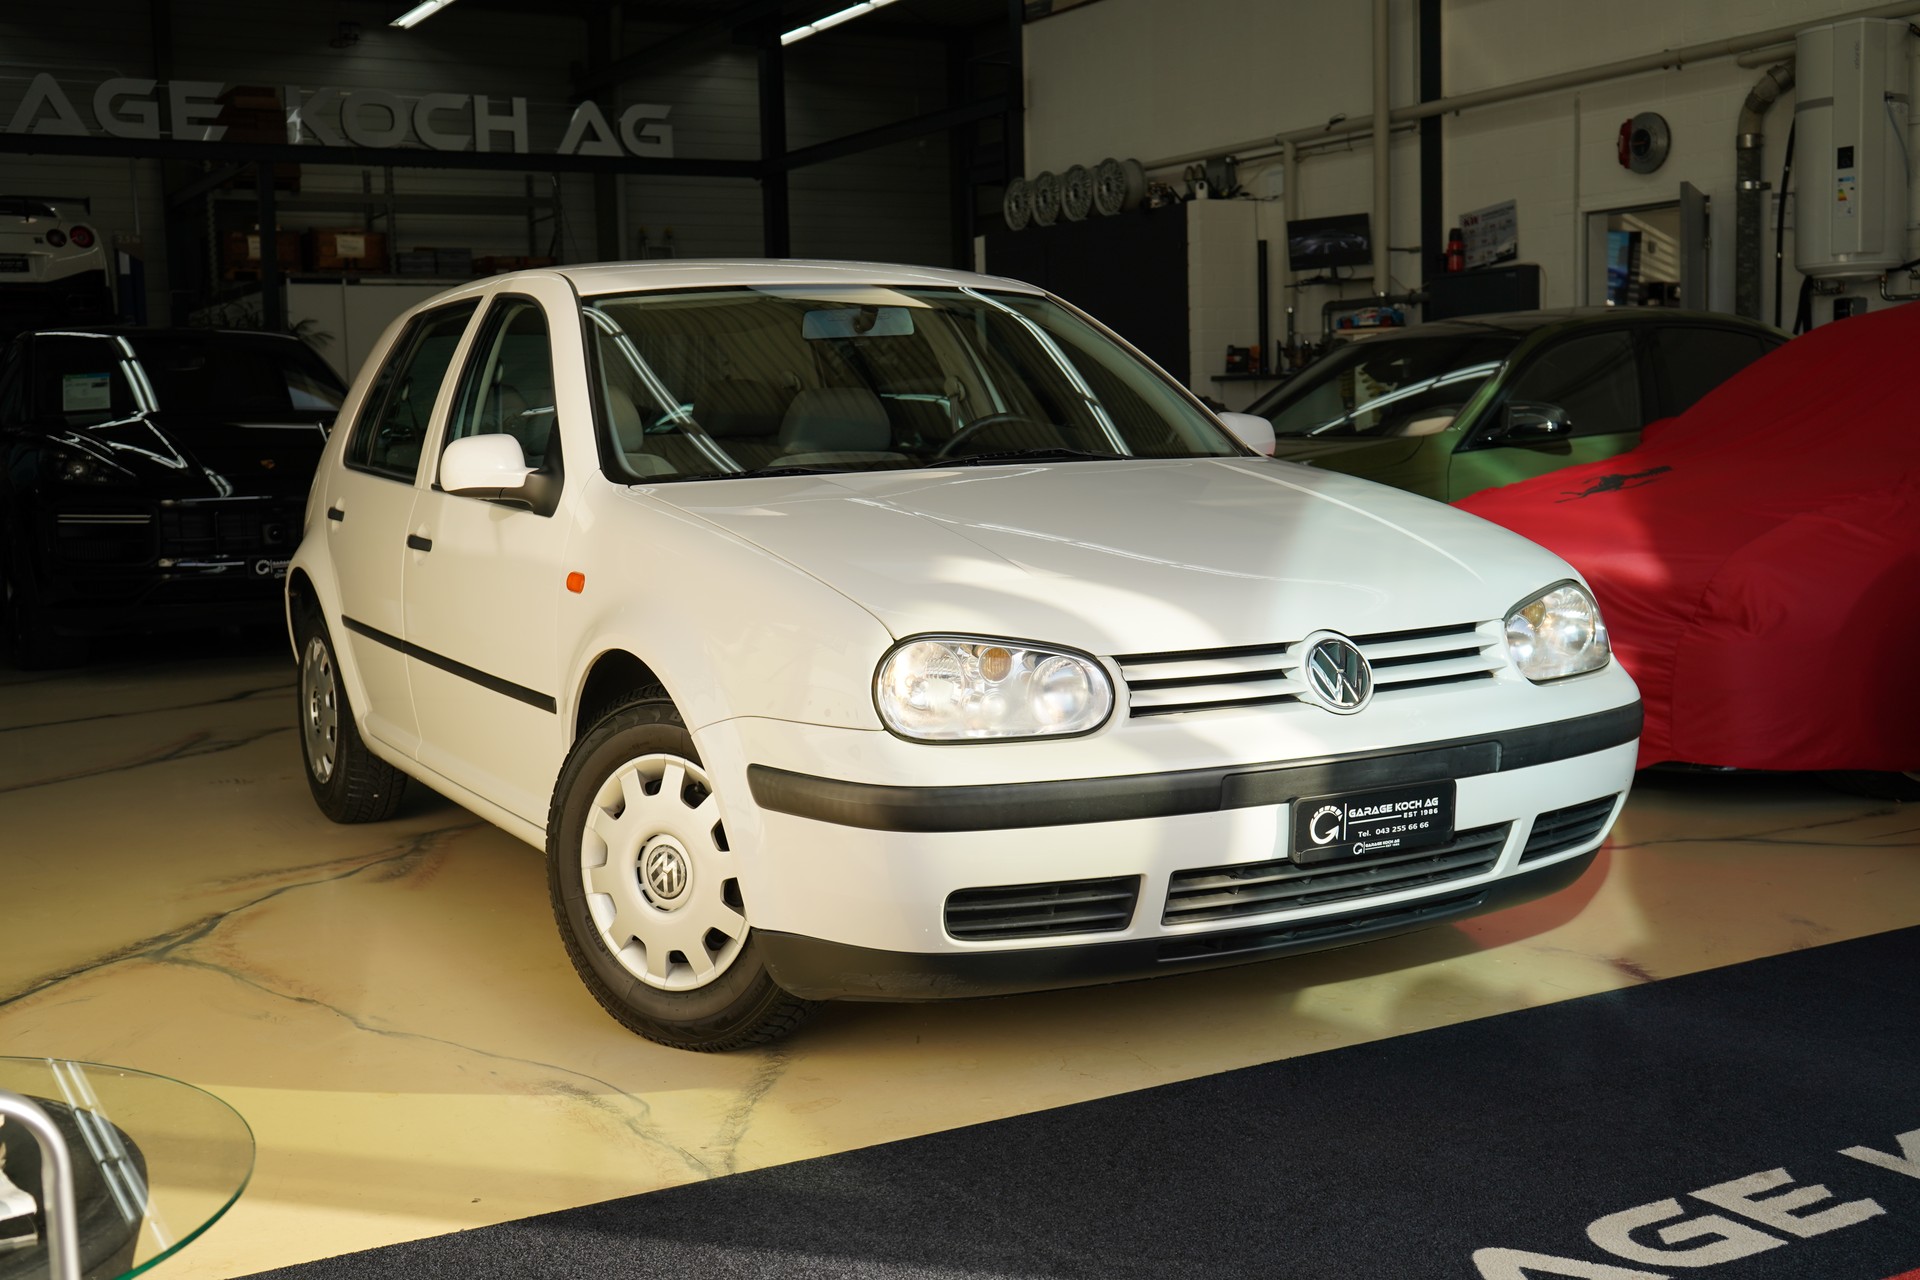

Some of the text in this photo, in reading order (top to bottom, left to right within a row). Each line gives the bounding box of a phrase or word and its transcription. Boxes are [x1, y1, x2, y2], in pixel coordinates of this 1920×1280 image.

[284, 85, 529, 153] KOCH
[557, 100, 674, 158] AG
[1348, 797, 1438, 818] GARAGE KOCH AG
[1421, 808, 1438, 816] 1986
[1358, 830, 1371, 838] Tel.
[1375, 827, 1390, 835] 043
[1392, 824, 1406, 833] 255
